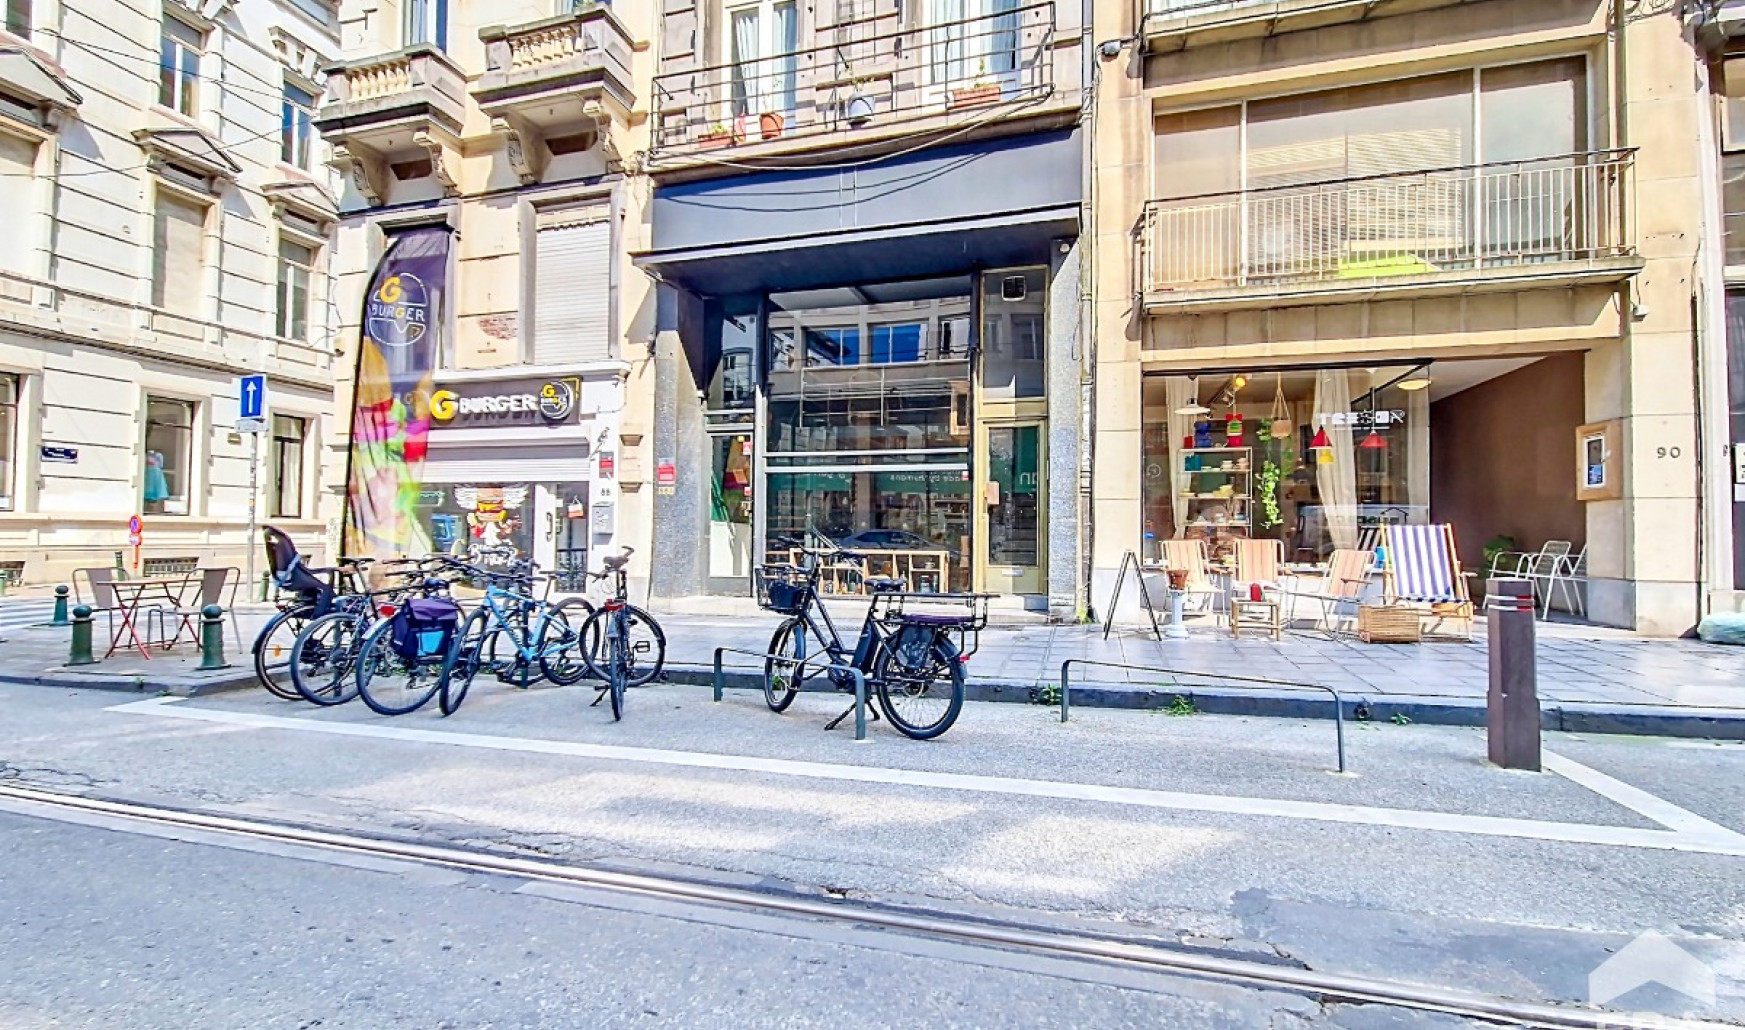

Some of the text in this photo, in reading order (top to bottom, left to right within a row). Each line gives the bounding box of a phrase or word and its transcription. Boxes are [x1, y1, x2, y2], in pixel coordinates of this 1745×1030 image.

[381, 276, 402, 303] G
[368, 304, 426, 322] BURGER
[429, 389, 539, 420] G BURGER
[1657, 446, 1681, 459] 90
